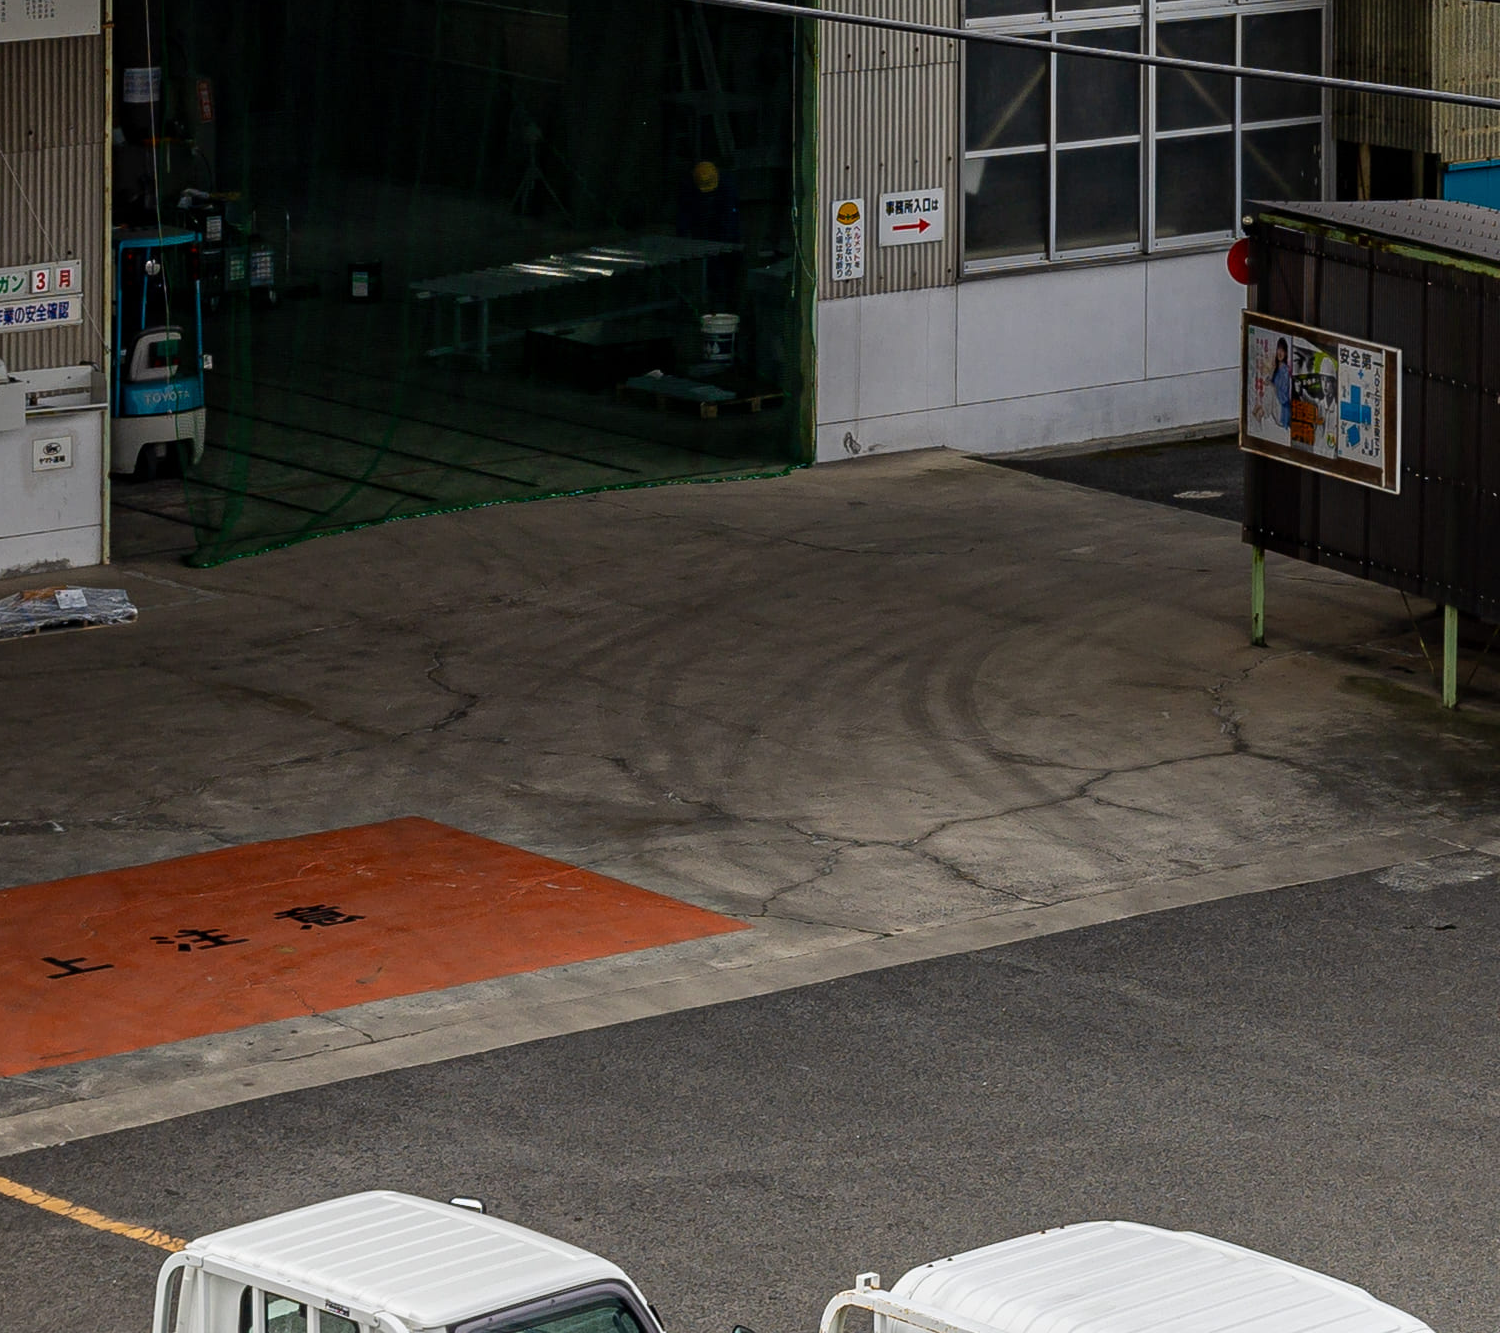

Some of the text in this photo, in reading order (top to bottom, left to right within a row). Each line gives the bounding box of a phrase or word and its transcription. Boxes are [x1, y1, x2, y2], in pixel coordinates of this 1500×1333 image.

[885, 197, 939, 216] 事務所入口は
[1339, 347, 1385, 371] 安全第一
[144, 390, 190, 405] TOYOTA
